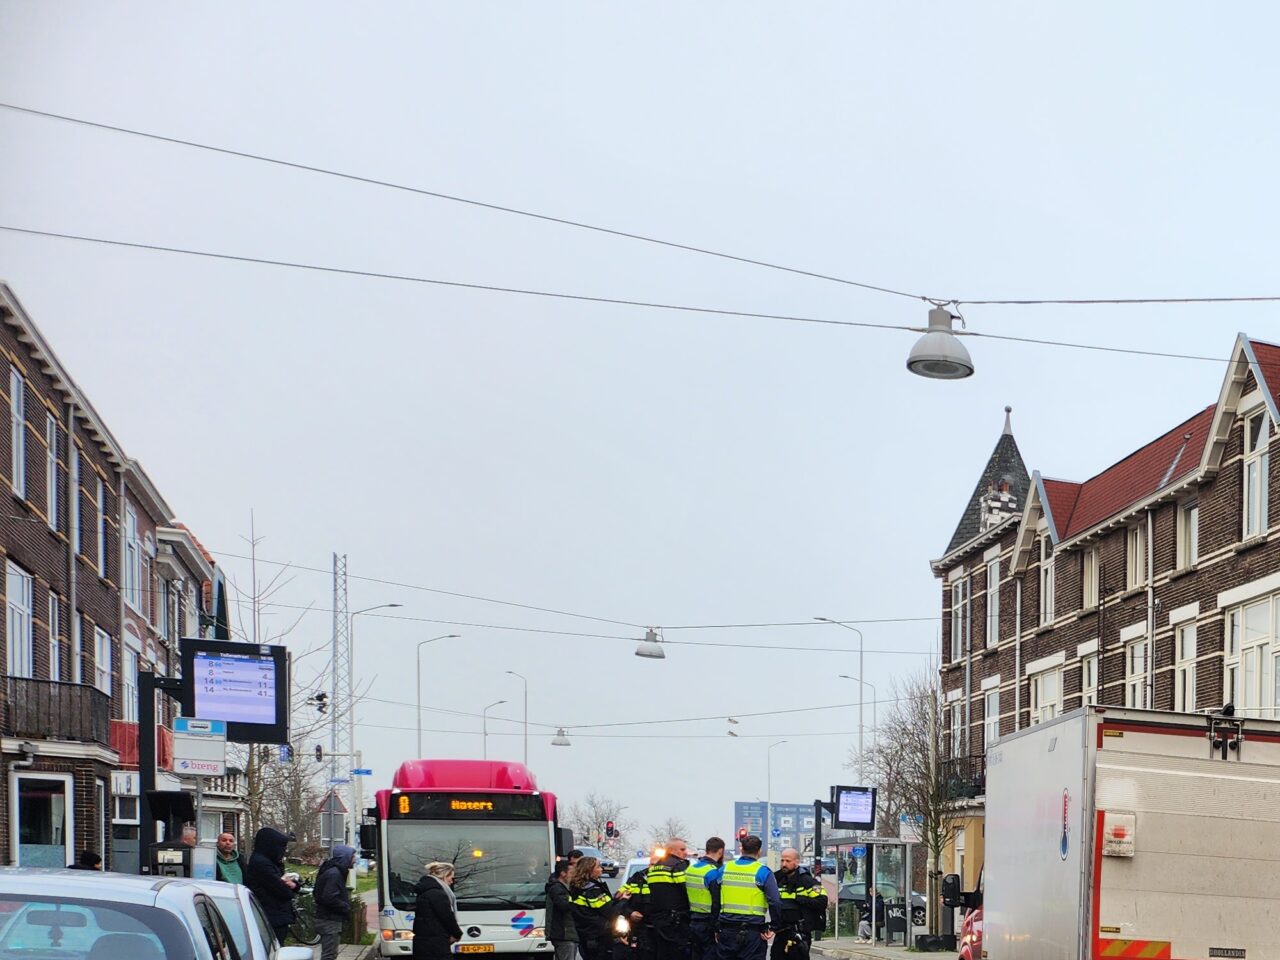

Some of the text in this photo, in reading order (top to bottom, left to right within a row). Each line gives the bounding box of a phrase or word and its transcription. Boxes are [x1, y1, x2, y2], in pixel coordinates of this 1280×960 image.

[191, 761, 219, 772] breng
[399, 796, 410, 814] 8
[451, 800, 493, 811] Hatert
